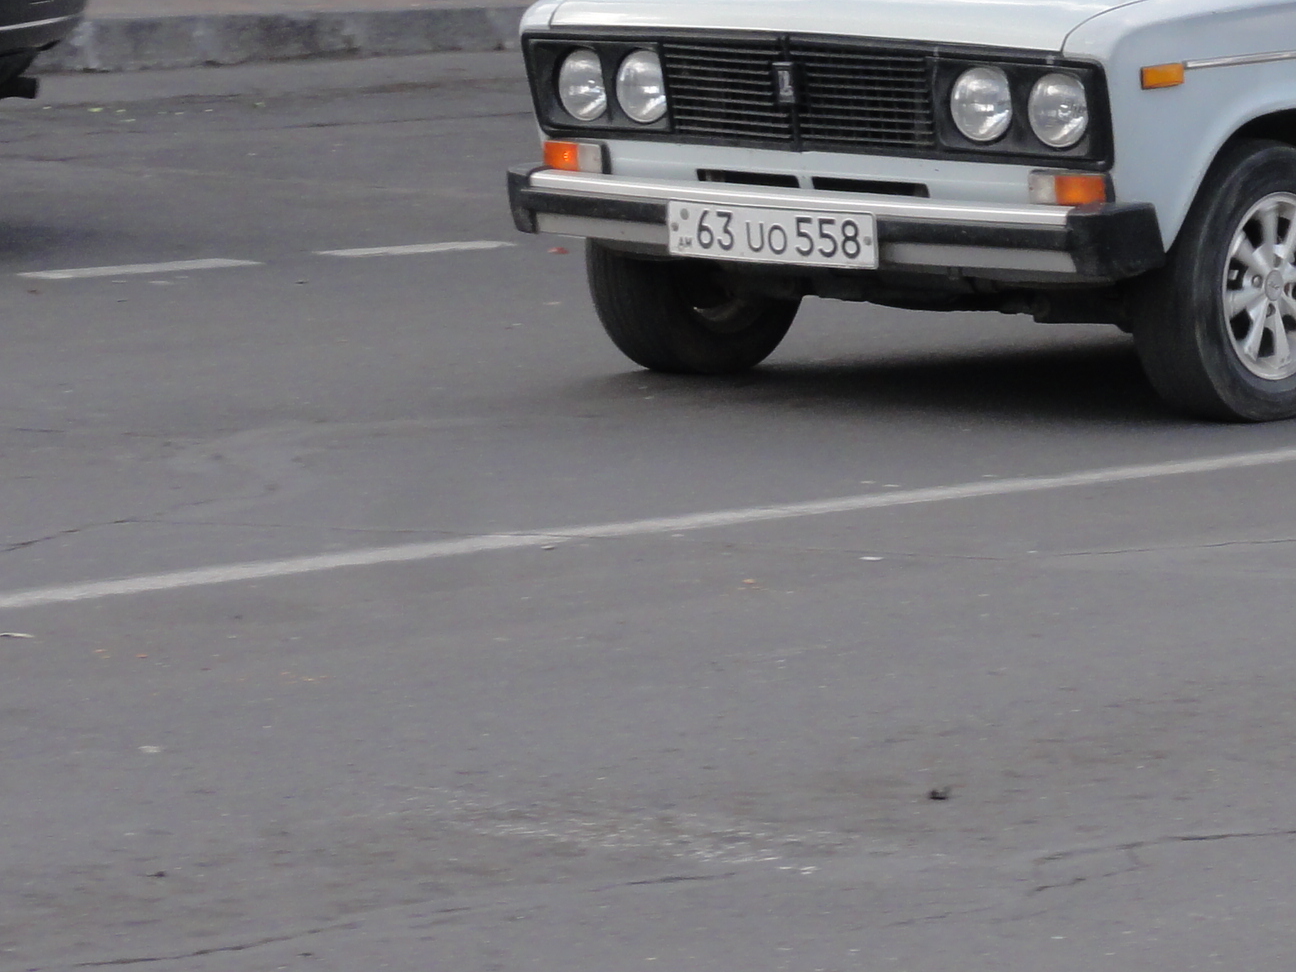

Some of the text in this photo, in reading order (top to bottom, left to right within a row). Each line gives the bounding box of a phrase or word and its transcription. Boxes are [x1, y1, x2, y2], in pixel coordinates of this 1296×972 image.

[696, 208, 862, 260] 63 UO 558
